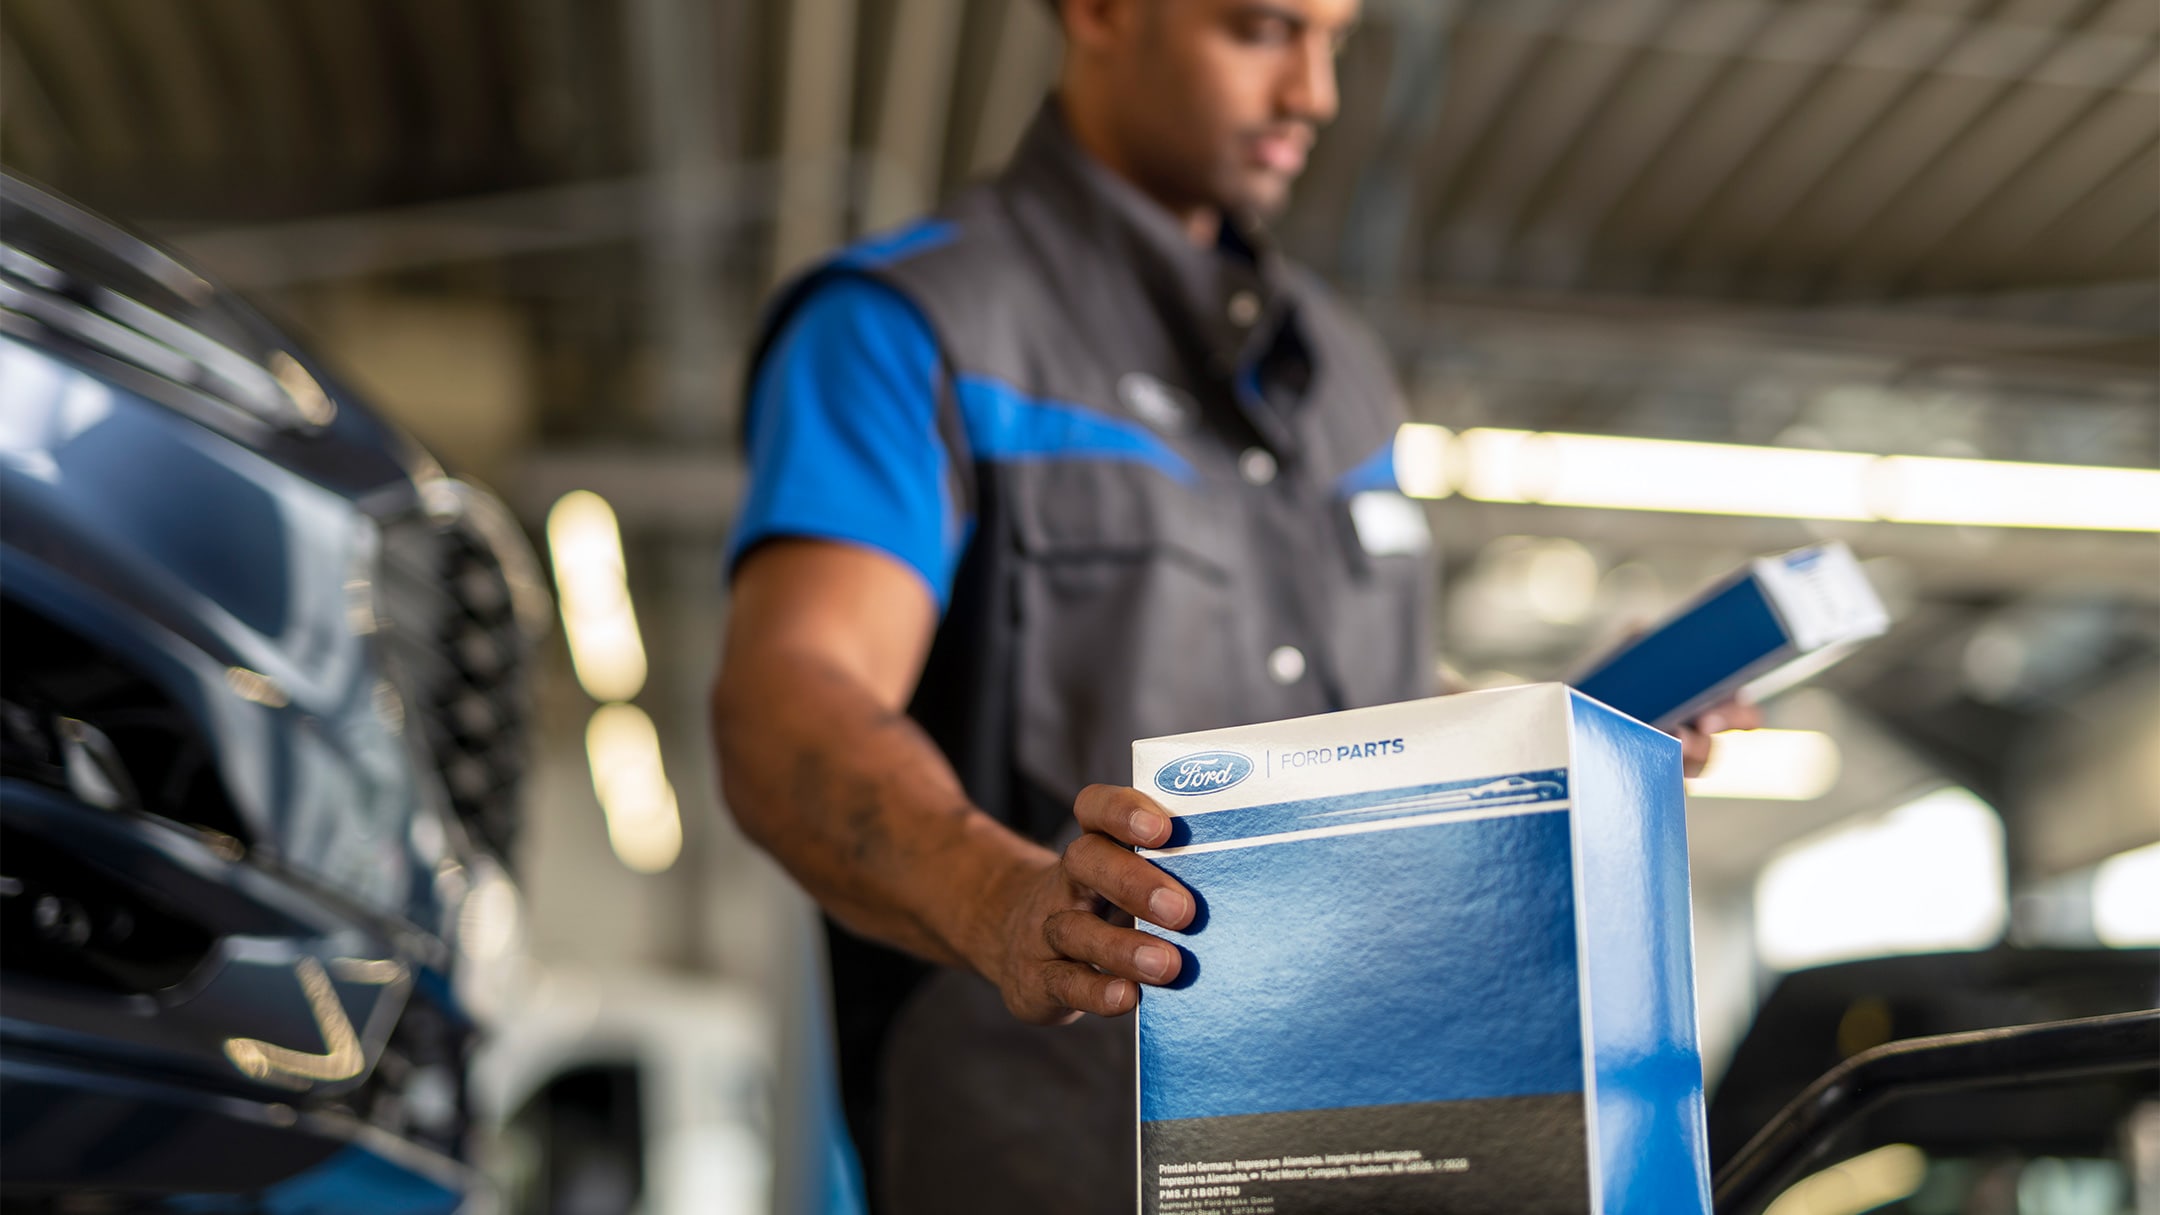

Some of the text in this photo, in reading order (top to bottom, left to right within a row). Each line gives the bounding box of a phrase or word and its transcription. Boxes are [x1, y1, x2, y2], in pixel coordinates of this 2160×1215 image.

[1281, 738, 1405, 769] FORD PARTS
[1174, 758, 1233, 790] Ford
[1159, 1162, 1187, 1174] Printed
[1188, 1161, 1196, 1173] in
[1235, 1158, 1269, 1171] Impreso
[1269, 1158, 1280, 1169] en
[1159, 1176, 1194, 1187] Impresso
[1195, 1175, 1206, 1185] na
[1261, 1169, 1280, 1181] Ford
[1281, 1168, 1306, 1180] Motor
[1159, 1200, 1192, 1210] Approved
